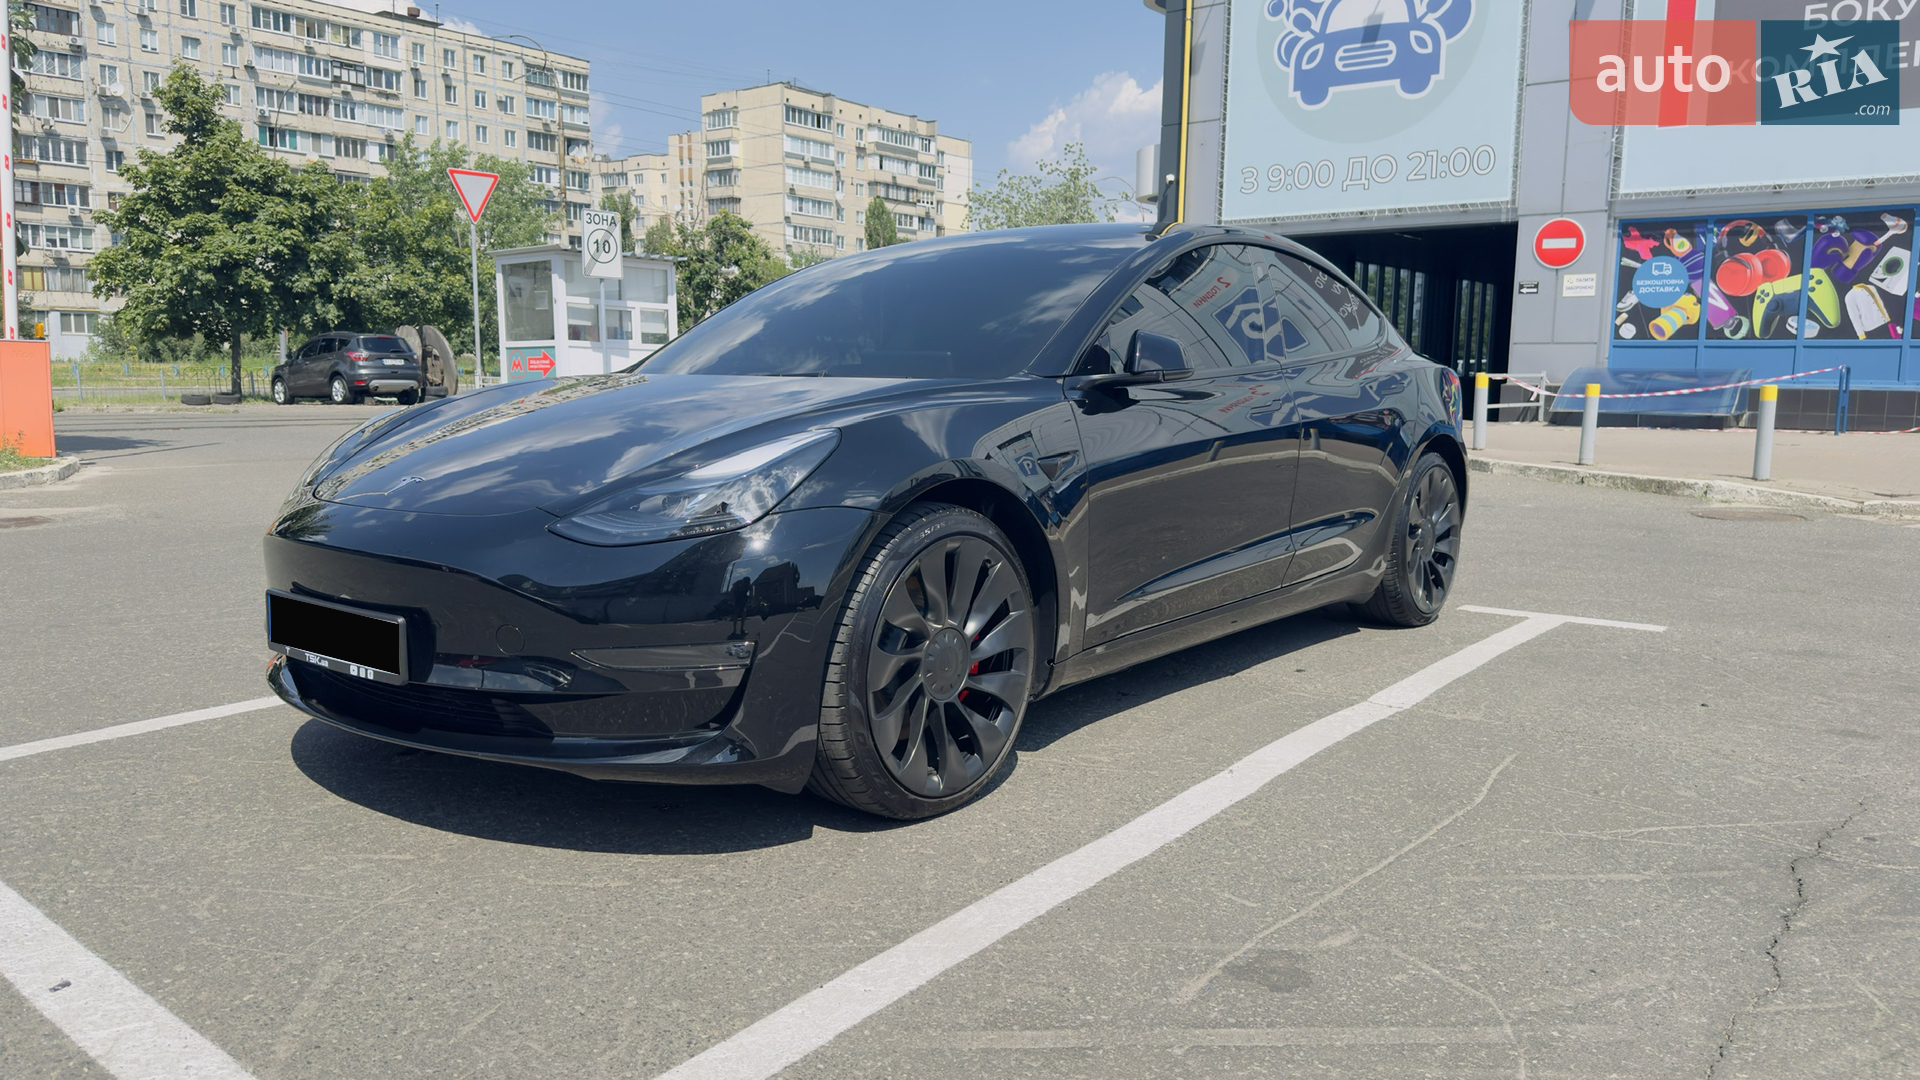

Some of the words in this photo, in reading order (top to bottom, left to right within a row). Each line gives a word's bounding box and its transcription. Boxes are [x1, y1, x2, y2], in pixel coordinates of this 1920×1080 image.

[1267, 159, 1335, 192] 9:00
[1341, 154, 1398, 192] ДО
[1406, 144, 1496, 181] 21:00
[585, 212, 617, 227] ЗОНА
[593, 238, 611, 254] 10
[1638, 285, 1681, 294] ДОСТАВКА
